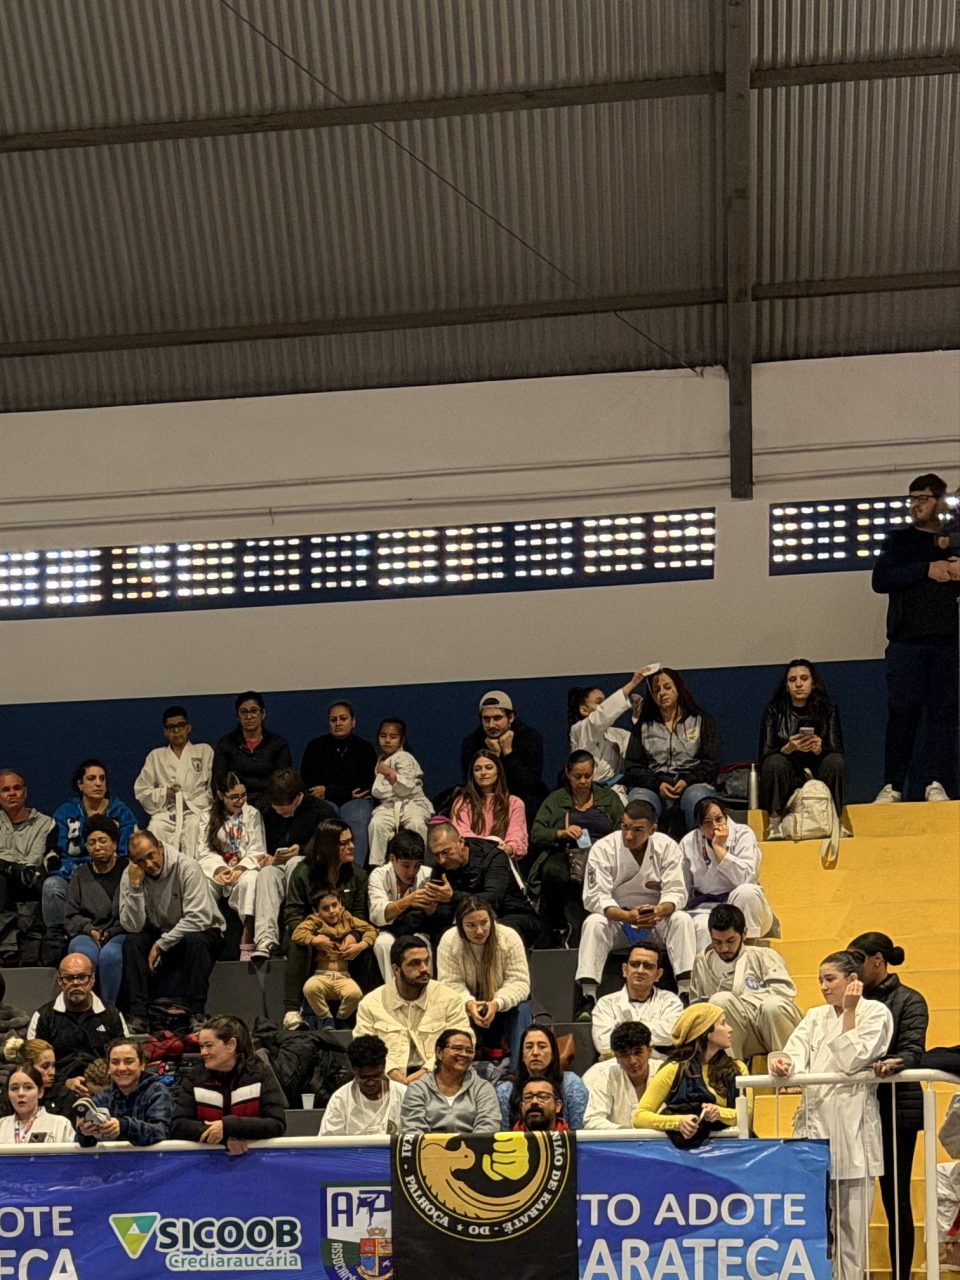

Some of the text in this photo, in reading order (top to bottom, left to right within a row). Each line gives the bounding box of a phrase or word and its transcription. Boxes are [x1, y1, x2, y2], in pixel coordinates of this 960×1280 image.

[401, 1133, 415, 1158] KAI
[550, 1130, 566, 1166] NIÃO
[547, 1169, 562, 1191] DE
[331, 1189, 392, 1228] AP
[404, 1174, 450, 1228] PALHOÇA
[653, 1193, 806, 1226] ADOTE
[159, 1218, 301, 1249] SICOOB
[468, 1225, 490, 1235] DO
[168, 1251, 300, 1269] Crediaraucária
